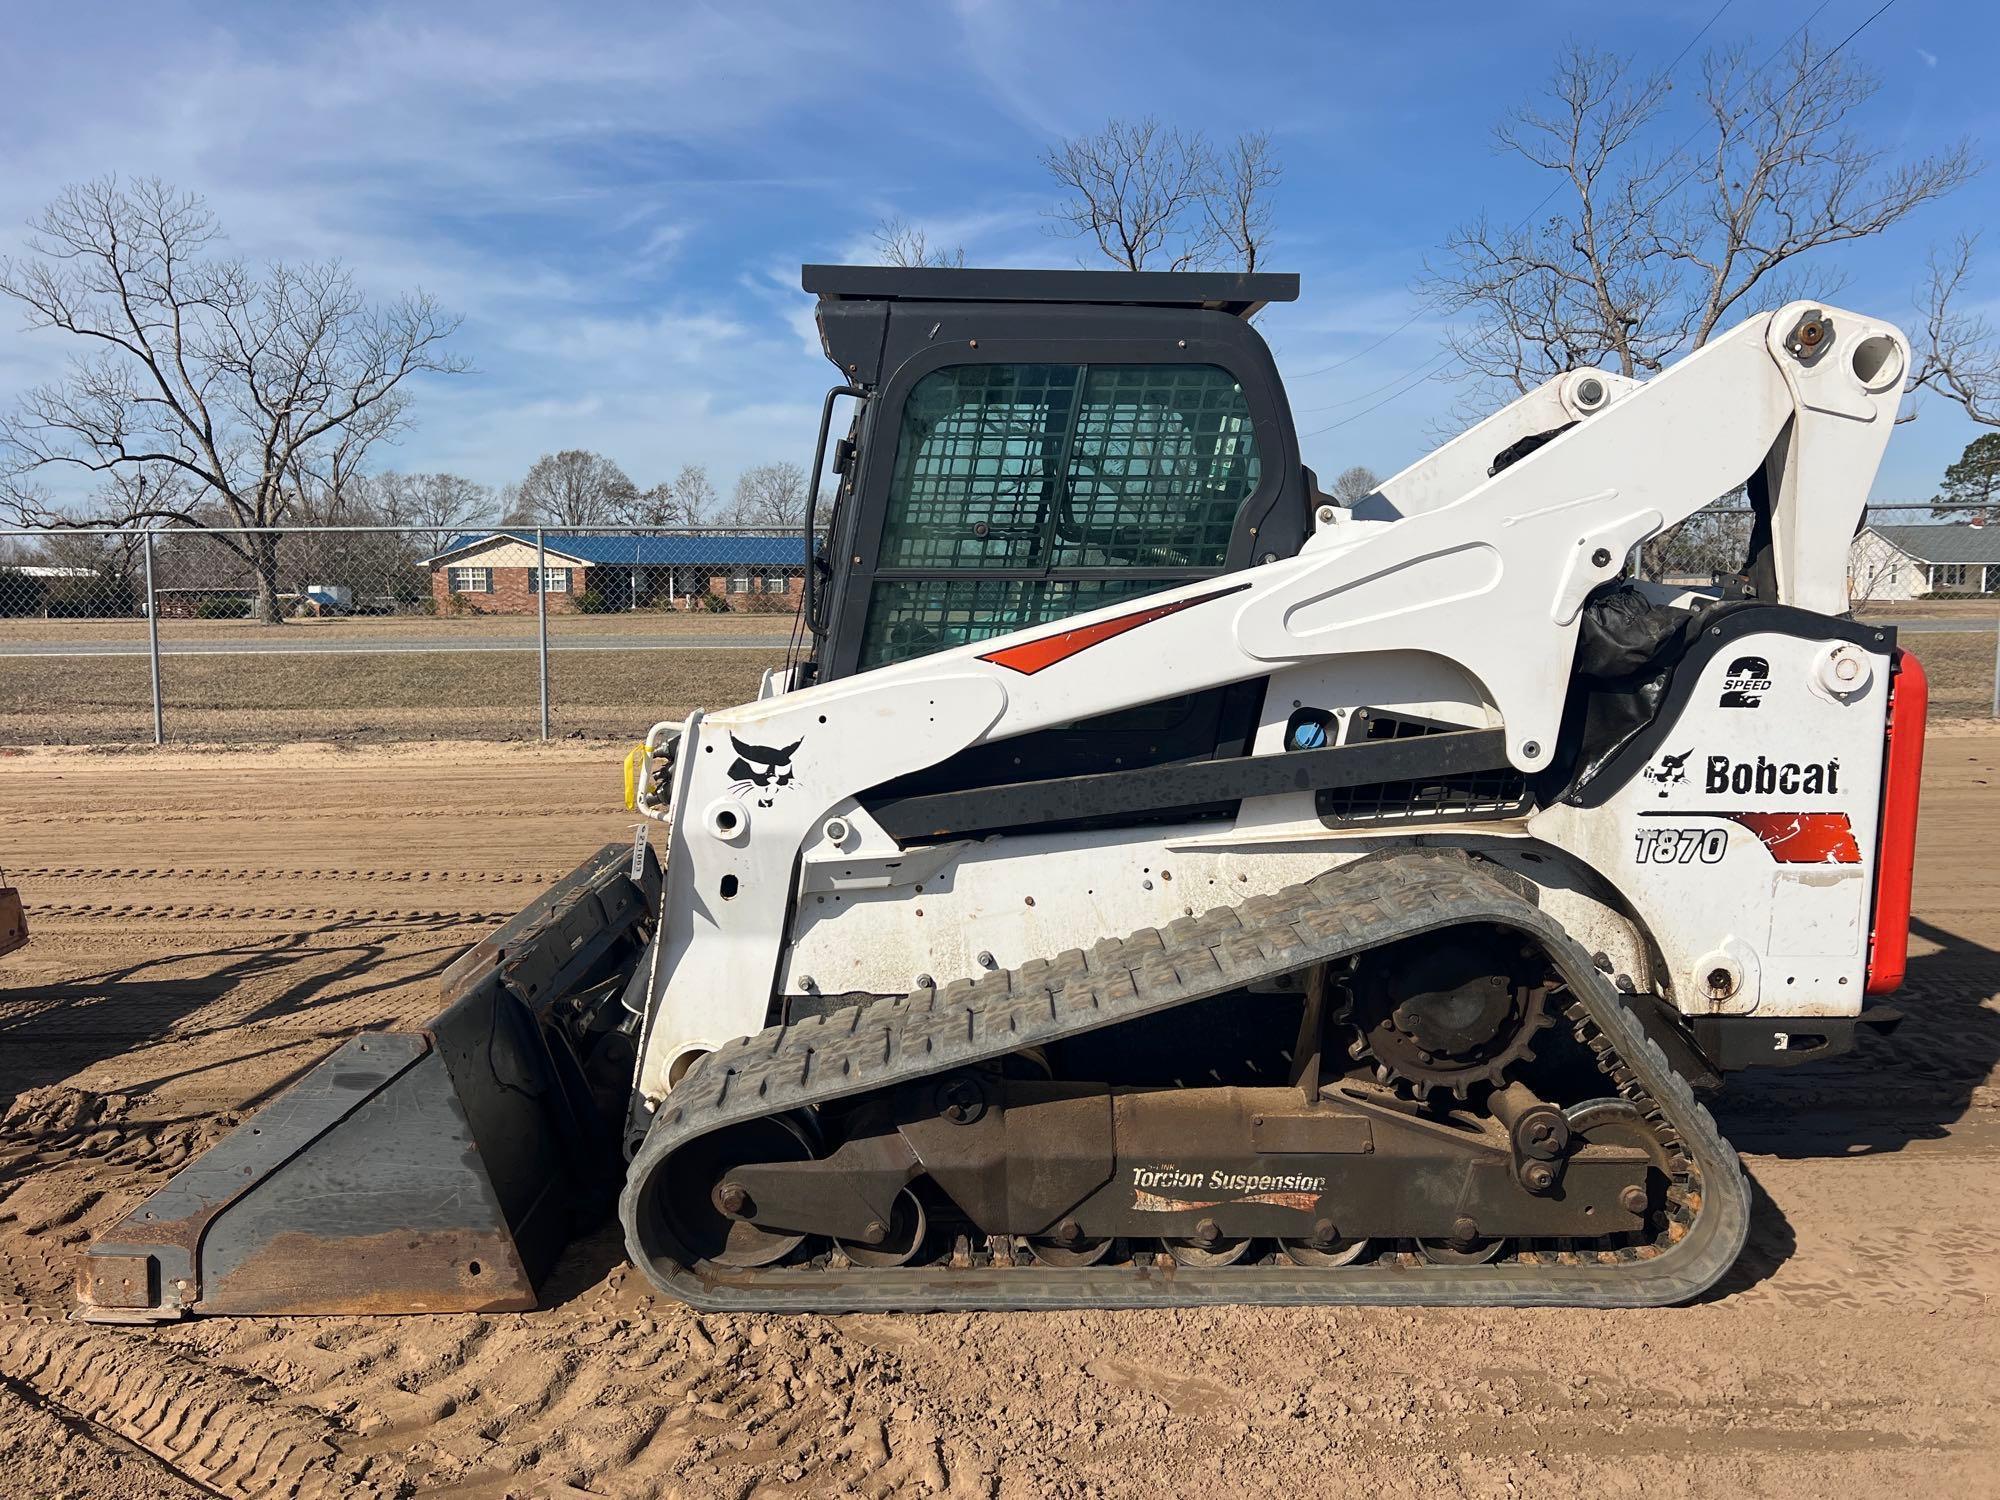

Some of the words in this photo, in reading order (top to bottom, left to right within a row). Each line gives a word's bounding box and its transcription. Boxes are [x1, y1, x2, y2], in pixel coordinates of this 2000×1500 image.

[1723, 680, 1772, 690] SPEED
[1705, 755, 1840, 795] Bobcat
[1635, 828, 1729, 864] T870
[1208, 1169, 1328, 1194] Suspension
